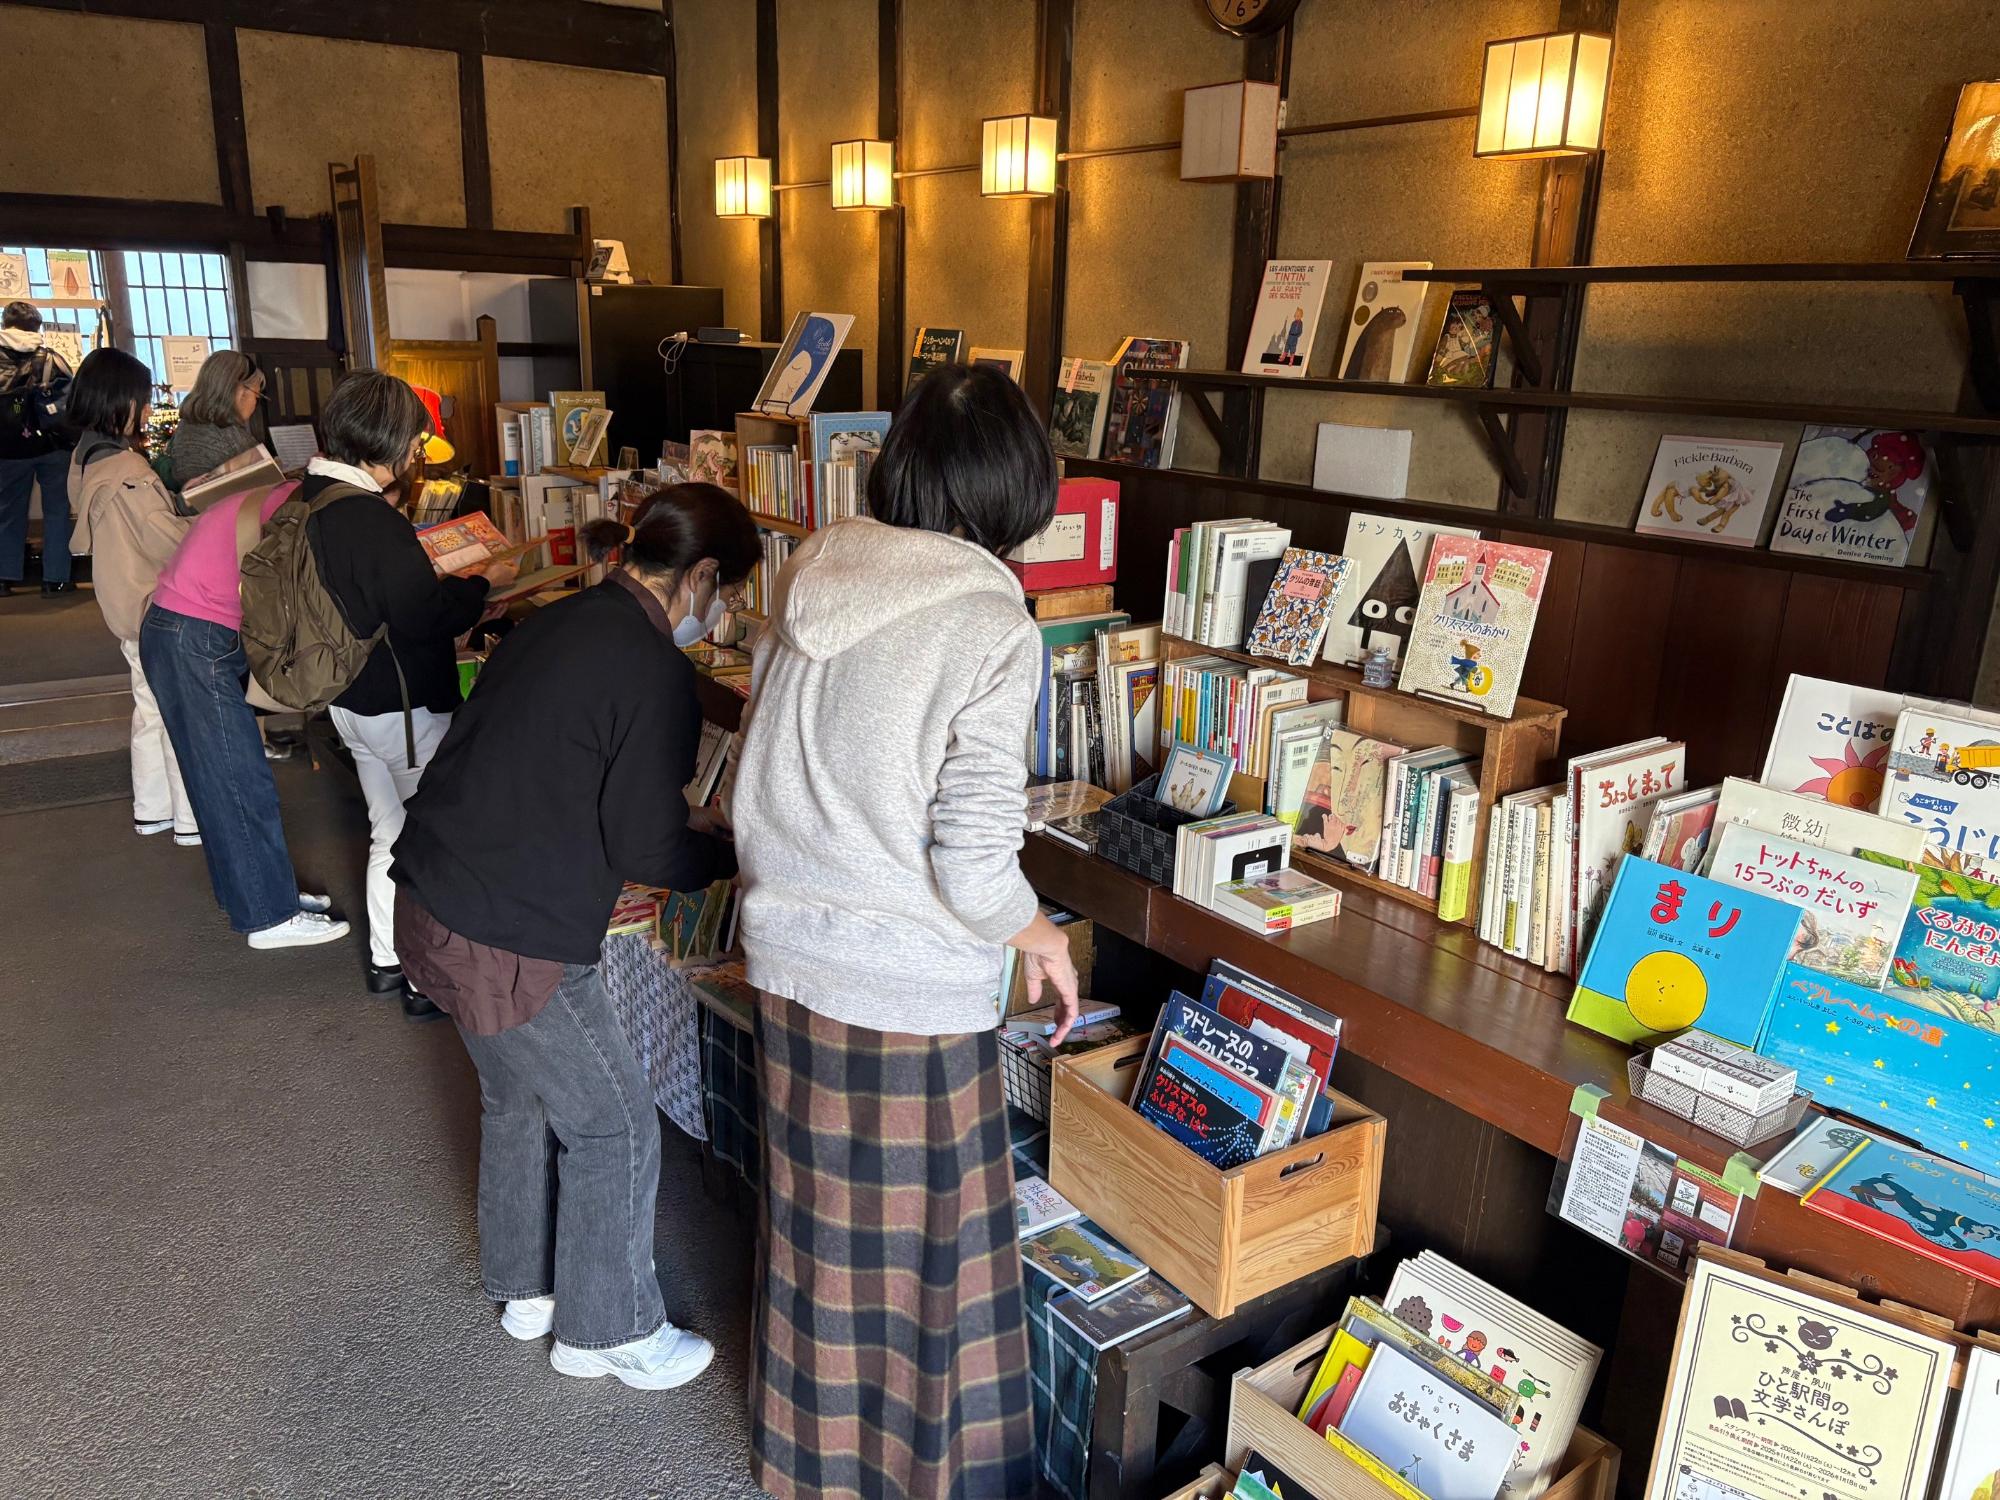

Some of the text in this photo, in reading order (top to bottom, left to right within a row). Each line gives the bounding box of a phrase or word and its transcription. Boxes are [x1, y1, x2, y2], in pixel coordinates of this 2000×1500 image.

[1236, 0, 1246, 17] 6
[1275, 273, 1306, 281] TINTIN
[1710, 452, 1754, 474] Barbara
[1786, 502, 1821, 520] First
[1793, 488, 1812, 501] The
[1358, 521, 1422, 542] サンカク
[1780, 520, 1897, 550] Day of Winter
[1837, 549, 1894, 562] Denise Fleming
[1432, 614, 1510, 640] クリスマスのあかり
[1816, 712, 1894, 742] ことばの
[1759, 844, 1864, 894] トットちゃんの
[1650, 879, 1742, 938] まり
[1734, 862, 1880, 919] 15つぶの だいず
[1916, 906, 2000, 945] くるみわ
[1181, 1004, 1254, 1059] マドレーヌの
[1790, 979, 1945, 1048] ベツレヘムへの道
[1196, 1035, 1260, 1081] クリスマス
[1151, 1088, 1210, 1139] ふしぎな はこ
[1156, 1073, 1208, 1118] クリスマスの
[1421, 1384, 1460, 1414] ぐり と ぐら
[1751, 1389, 1850, 1437] 文学さんぽ
[1758, 1371, 1849, 1416] ひと駅間の
[1388, 1390, 1475, 1462] おきゃくさま
